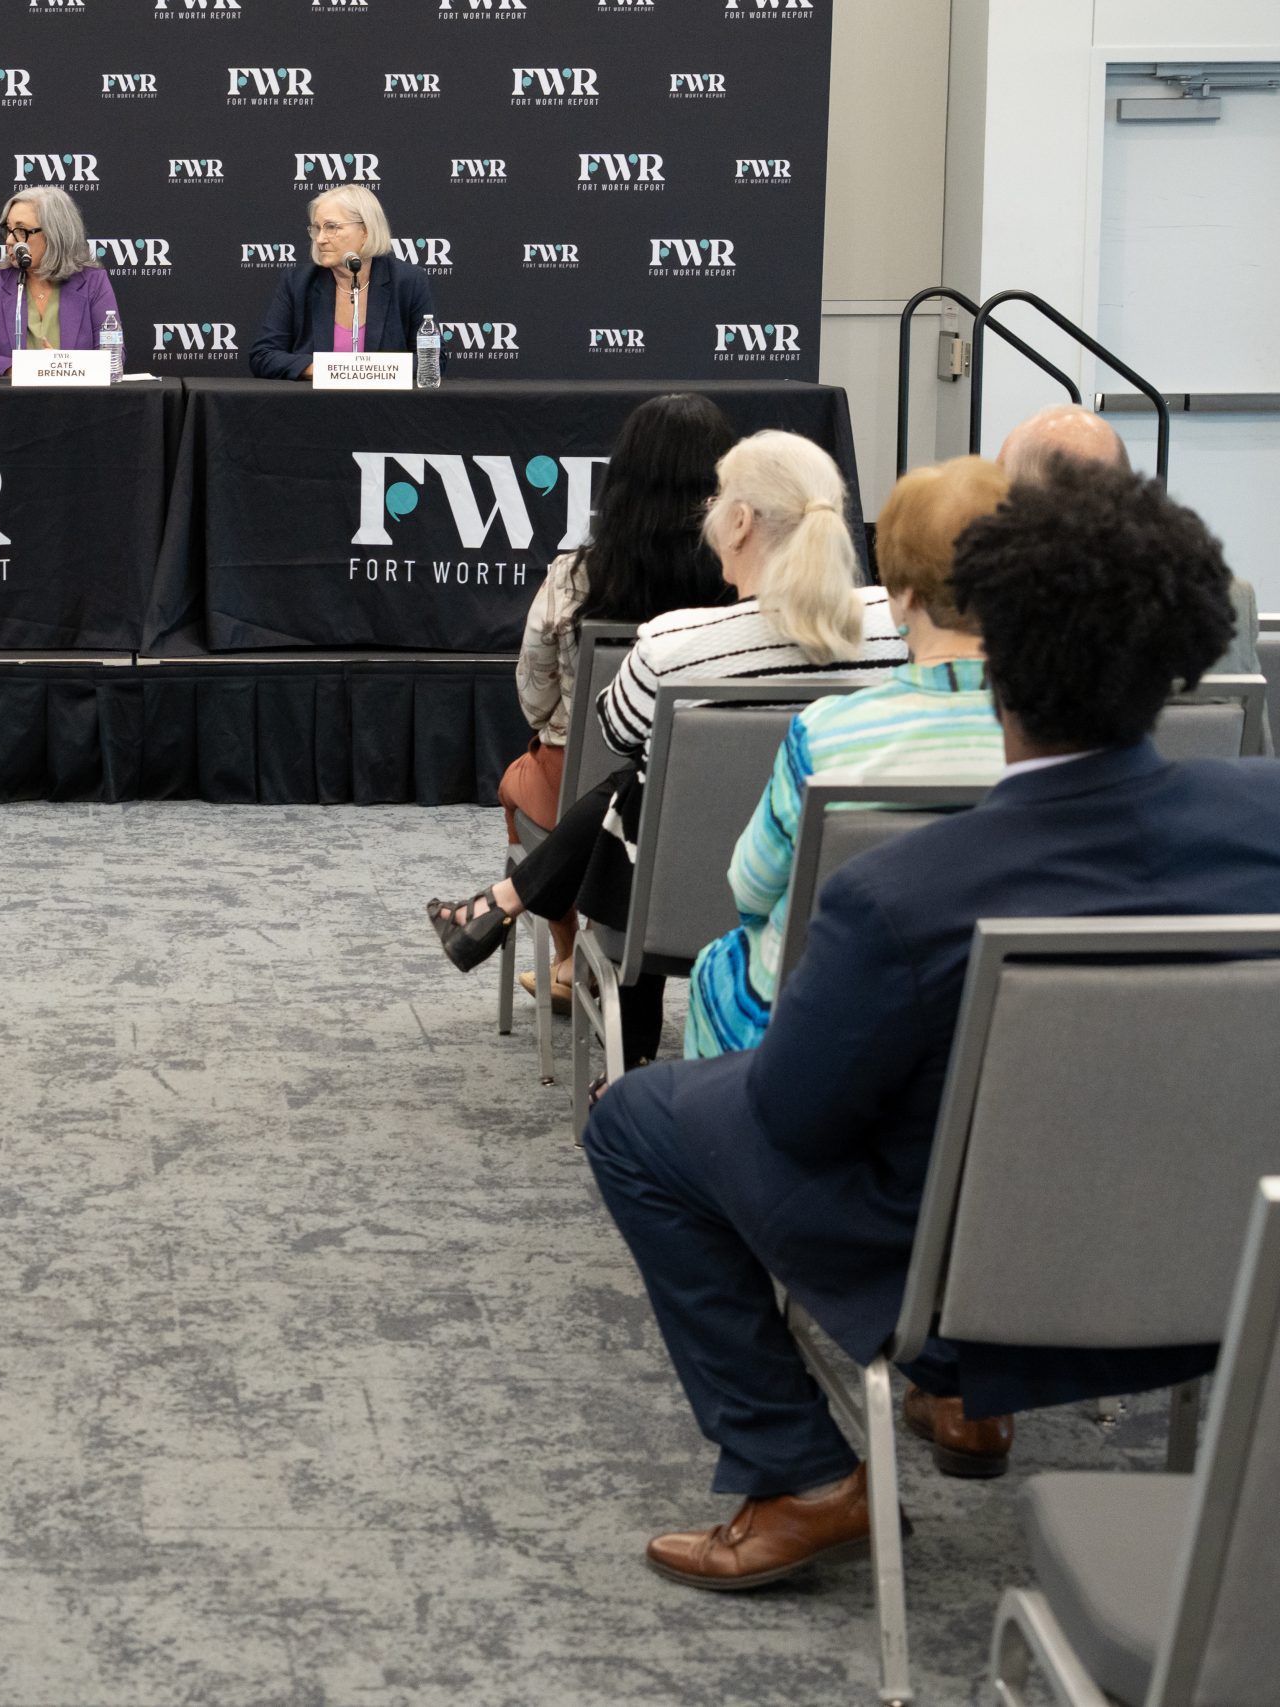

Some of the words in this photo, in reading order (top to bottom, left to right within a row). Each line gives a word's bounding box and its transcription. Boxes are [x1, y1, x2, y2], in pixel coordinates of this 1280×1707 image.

[154, 11, 175, 20] FORT
[177, 11, 206, 20] WORTH
[210, 11, 242, 20] REPORT
[438, 11, 459, 20] FORT
[462, 11, 491, 20] WORTH
[494, 11, 527, 20] REPORT
[724, 10, 746, 20] FORT
[748, 10, 778, 20] WORTH
[781, 10, 814, 20] REPORT
[102, 74, 157, 92] FWR
[228, 68, 314, 95] FWR
[384, 74, 440, 91] FWR
[512, 68, 599, 95] FWR
[670, 74, 726, 91] FWR
[1, 98, 33, 107] REPORT
[226, 97, 247, 106] FORT
[250, 97, 279, 106] WORTH
[282, 97, 314, 106] REPORT
[510, 97, 532, 106] FORT
[534, 97, 564, 106] WORTH
[567, 97, 599, 106] REPORT
[14, 154, 99, 181] FWR
[169, 159, 224, 177] FWR
[294, 154, 381, 180] FWR
[451, 159, 507, 177] FWR
[578, 154, 665, 180] FWR
[735, 160, 791, 177] FWR
[68, 183, 100, 192] REPORT
[577, 183, 598, 192] FORT
[601, 183, 630, 192] WORTH
[633, 183, 666, 192] REPORT
[88, 239, 172, 265] FWR
[241, 244, 296, 261] FWR
[390, 238, 453, 265] WR
[523, 244, 579, 261] FWR
[649, 239, 736, 266] FWR
[109, 268, 138, 276] WORTH
[141, 268, 173, 276] REPORT
[423, 267, 453, 275] EPORT
[648, 268, 669, 277] FORT
[672, 268, 701, 277] WORTH
[704, 268, 736, 277] REPORT
[154, 323, 238, 350] FWR
[590, 329, 645, 346] FWR
[715, 324, 800, 351] FWR
[152, 352, 173, 360] FORT
[176, 352, 204, 360] WORTH
[207, 352, 239, 360] REPORT
[456, 351, 484, 360] WORTH
[488, 351, 520, 360] REPORT
[713, 353, 734, 362] FORT
[737, 353, 766, 362] WORTH
[769, 353, 801, 362] REPORT
[37, 369, 86, 377] BRENNAN
[330, 372, 396, 380] MCLAUGHLIN
[351, 364, 399, 372] LLEWELLYN
[349, 558, 416, 582] FORT
[433, 561, 526, 585] WORTH
